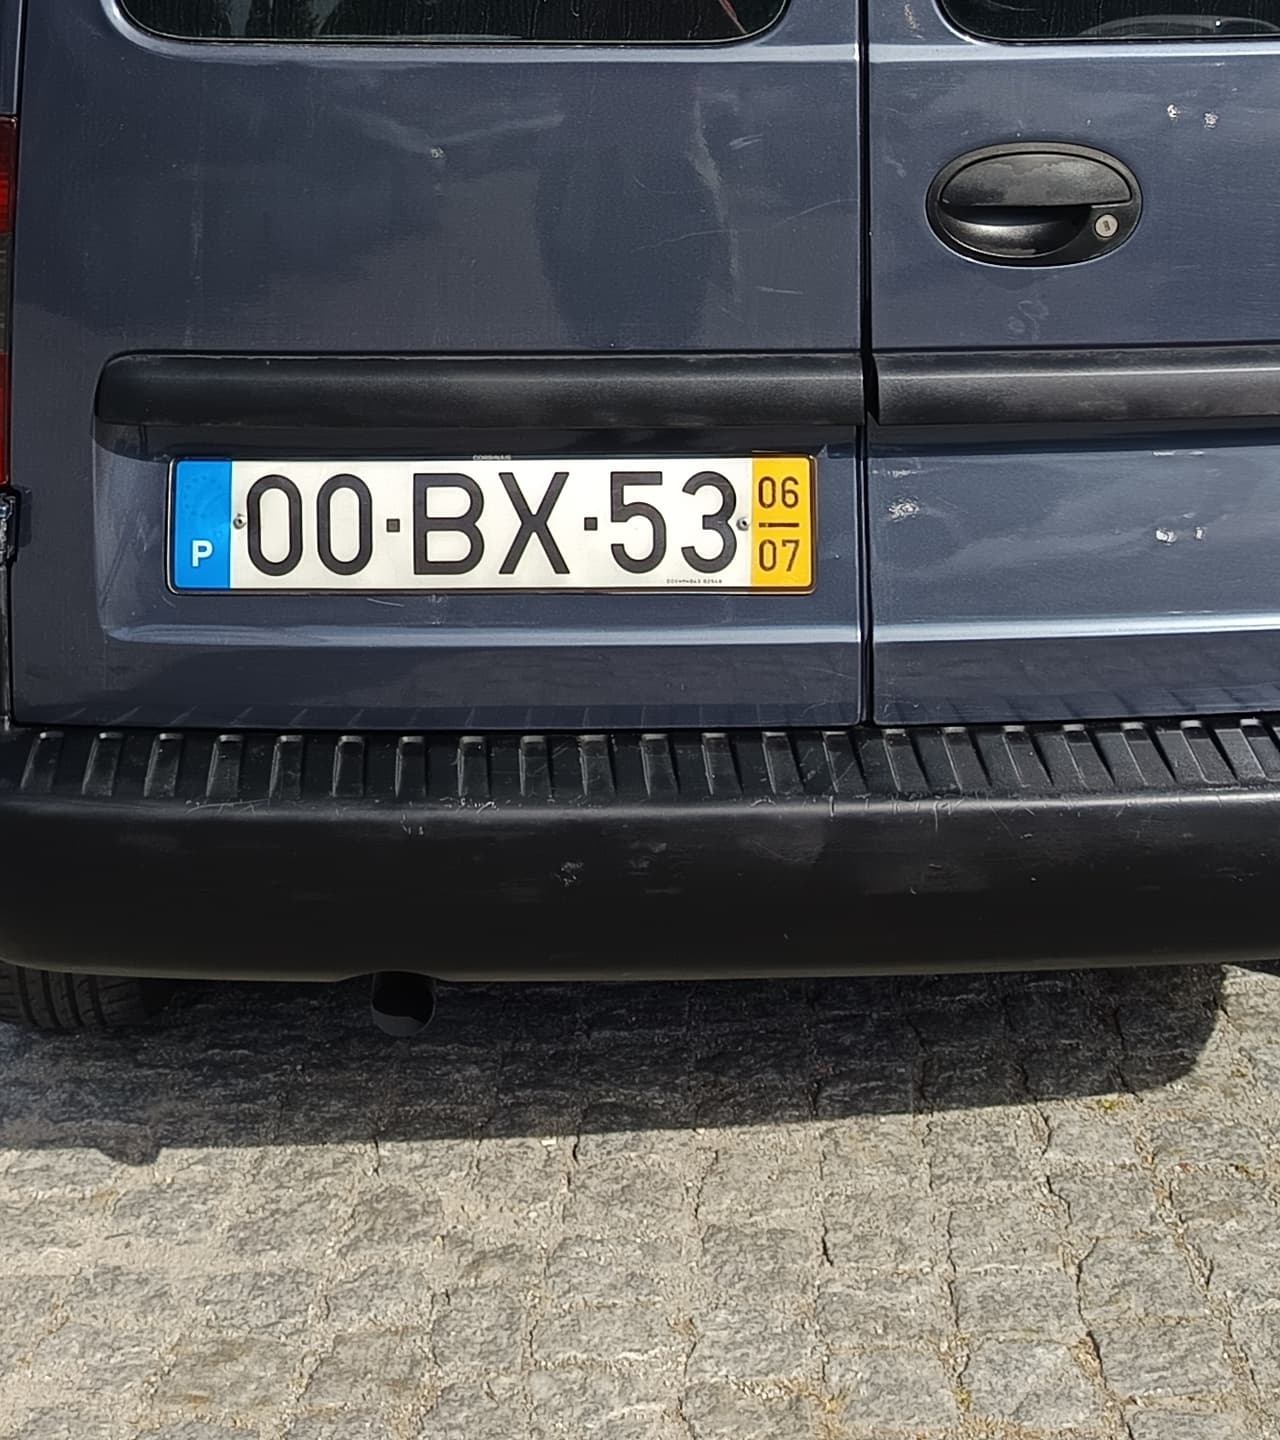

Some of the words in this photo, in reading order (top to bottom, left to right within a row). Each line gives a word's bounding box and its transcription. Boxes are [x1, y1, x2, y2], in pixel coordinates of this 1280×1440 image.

[758, 476, 799, 509] 06
[191, 539, 214, 568] P
[759, 539, 800, 572] 07
